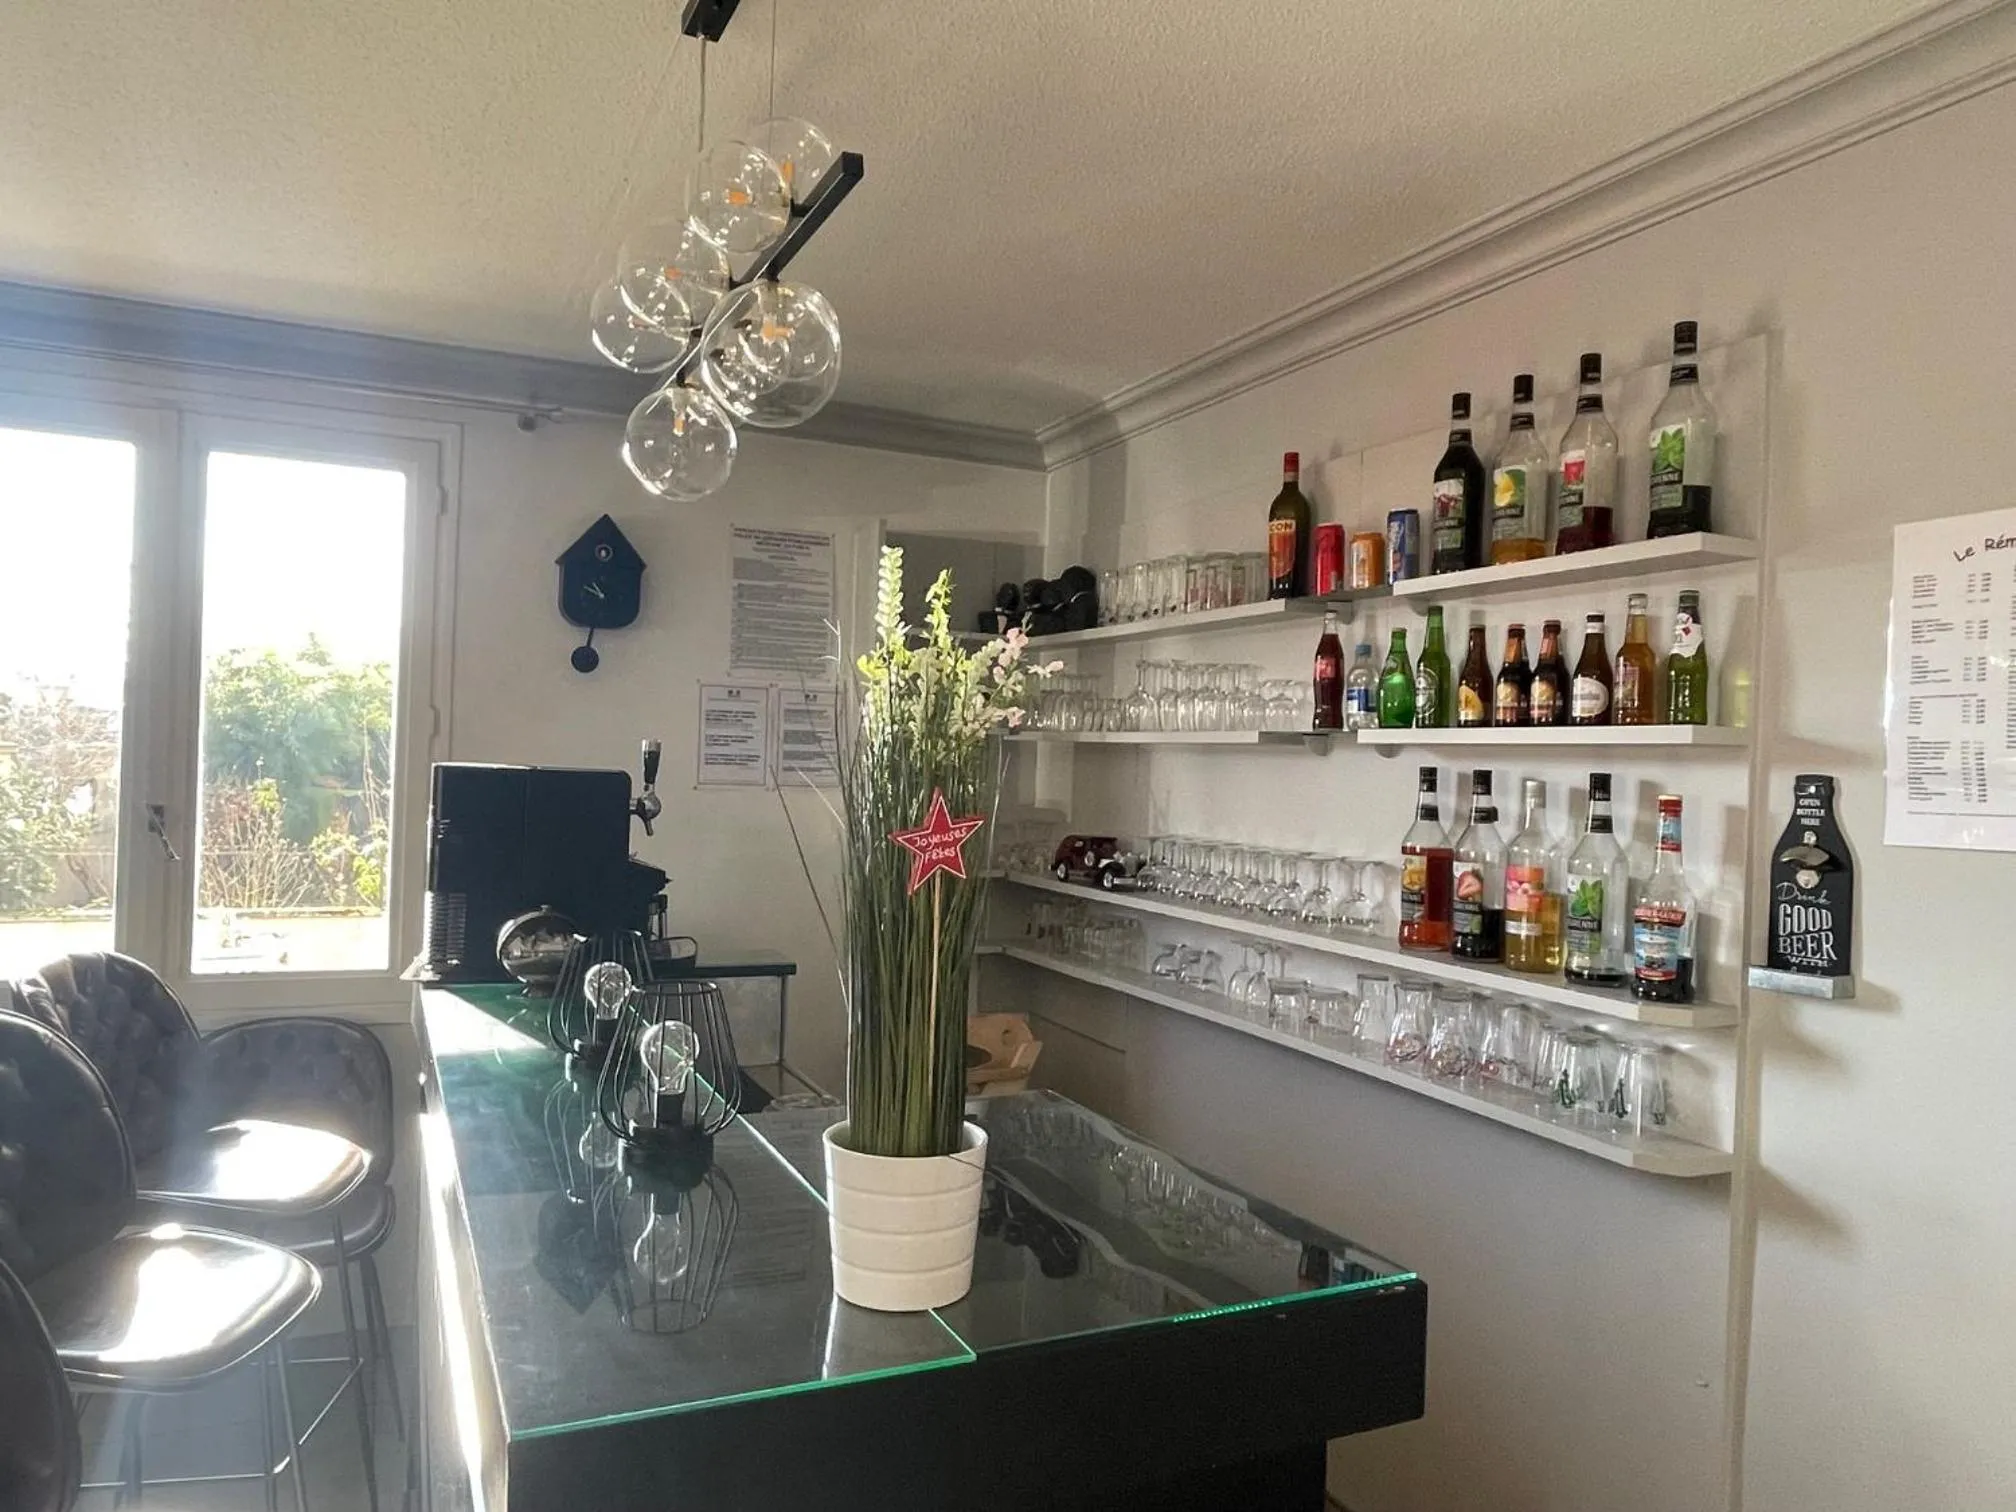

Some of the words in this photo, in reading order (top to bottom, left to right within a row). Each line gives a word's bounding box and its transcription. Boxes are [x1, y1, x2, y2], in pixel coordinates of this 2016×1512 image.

[1953, 546, 1976, 562] Le
[1776, 882, 1831, 904] Drink
[1778, 903, 1832, 936] GOOD
[1778, 931, 1838, 960] BEER
